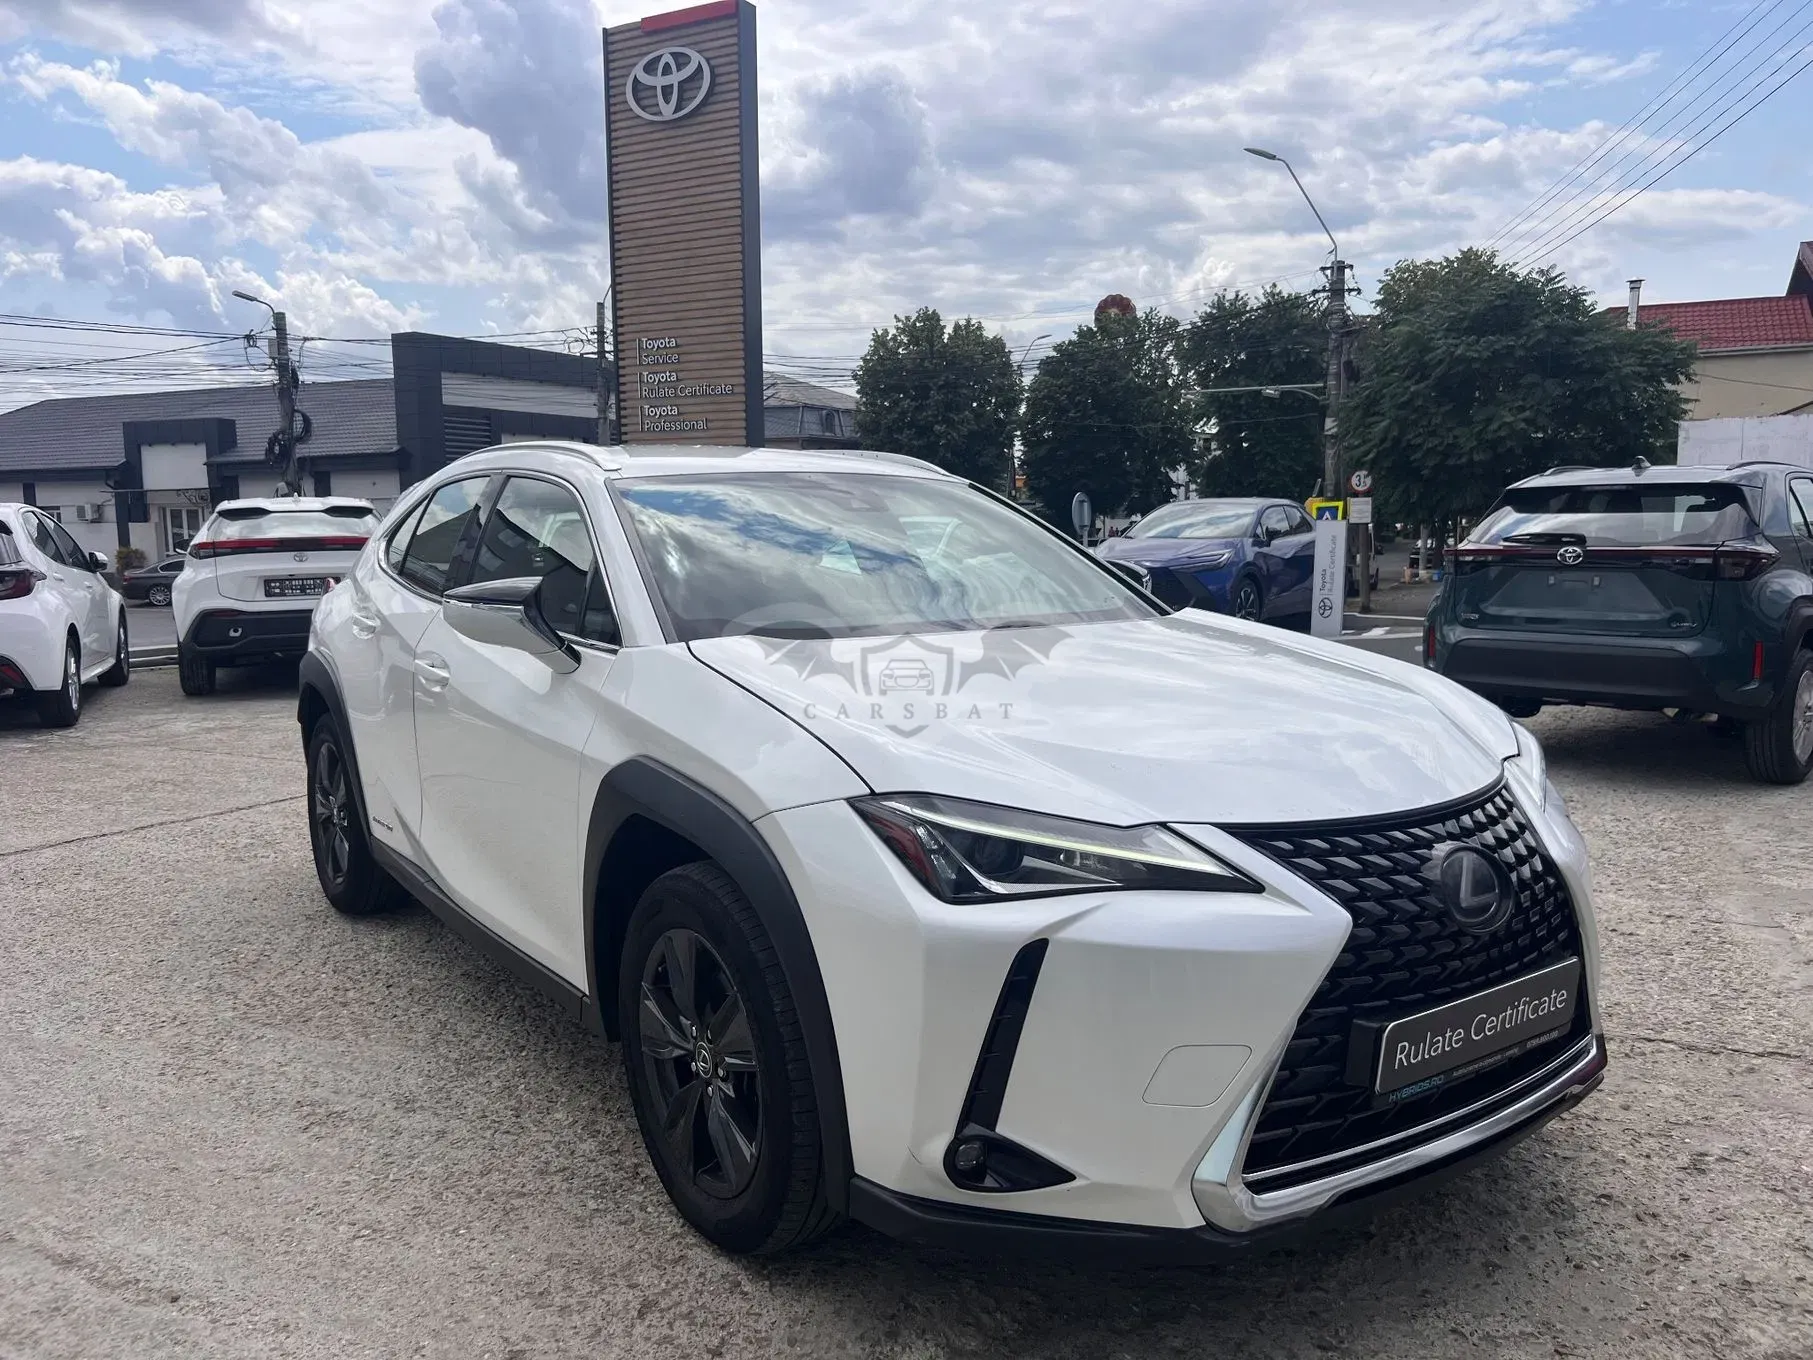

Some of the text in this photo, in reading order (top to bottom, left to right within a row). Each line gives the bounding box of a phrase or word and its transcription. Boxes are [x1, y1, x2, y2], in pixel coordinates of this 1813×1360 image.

[642, 337, 676, 350] Toyota
[642, 352, 679, 365] Service
[642, 371, 677, 384] Toyota
[642, 382, 733, 399] Rulate Certificate
[644, 405, 678, 418] Toyota
[644, 418, 708, 431] Professional
[1394, 1026, 1464, 1070] Rulate
[1470, 988, 1567, 1041] Certificate
